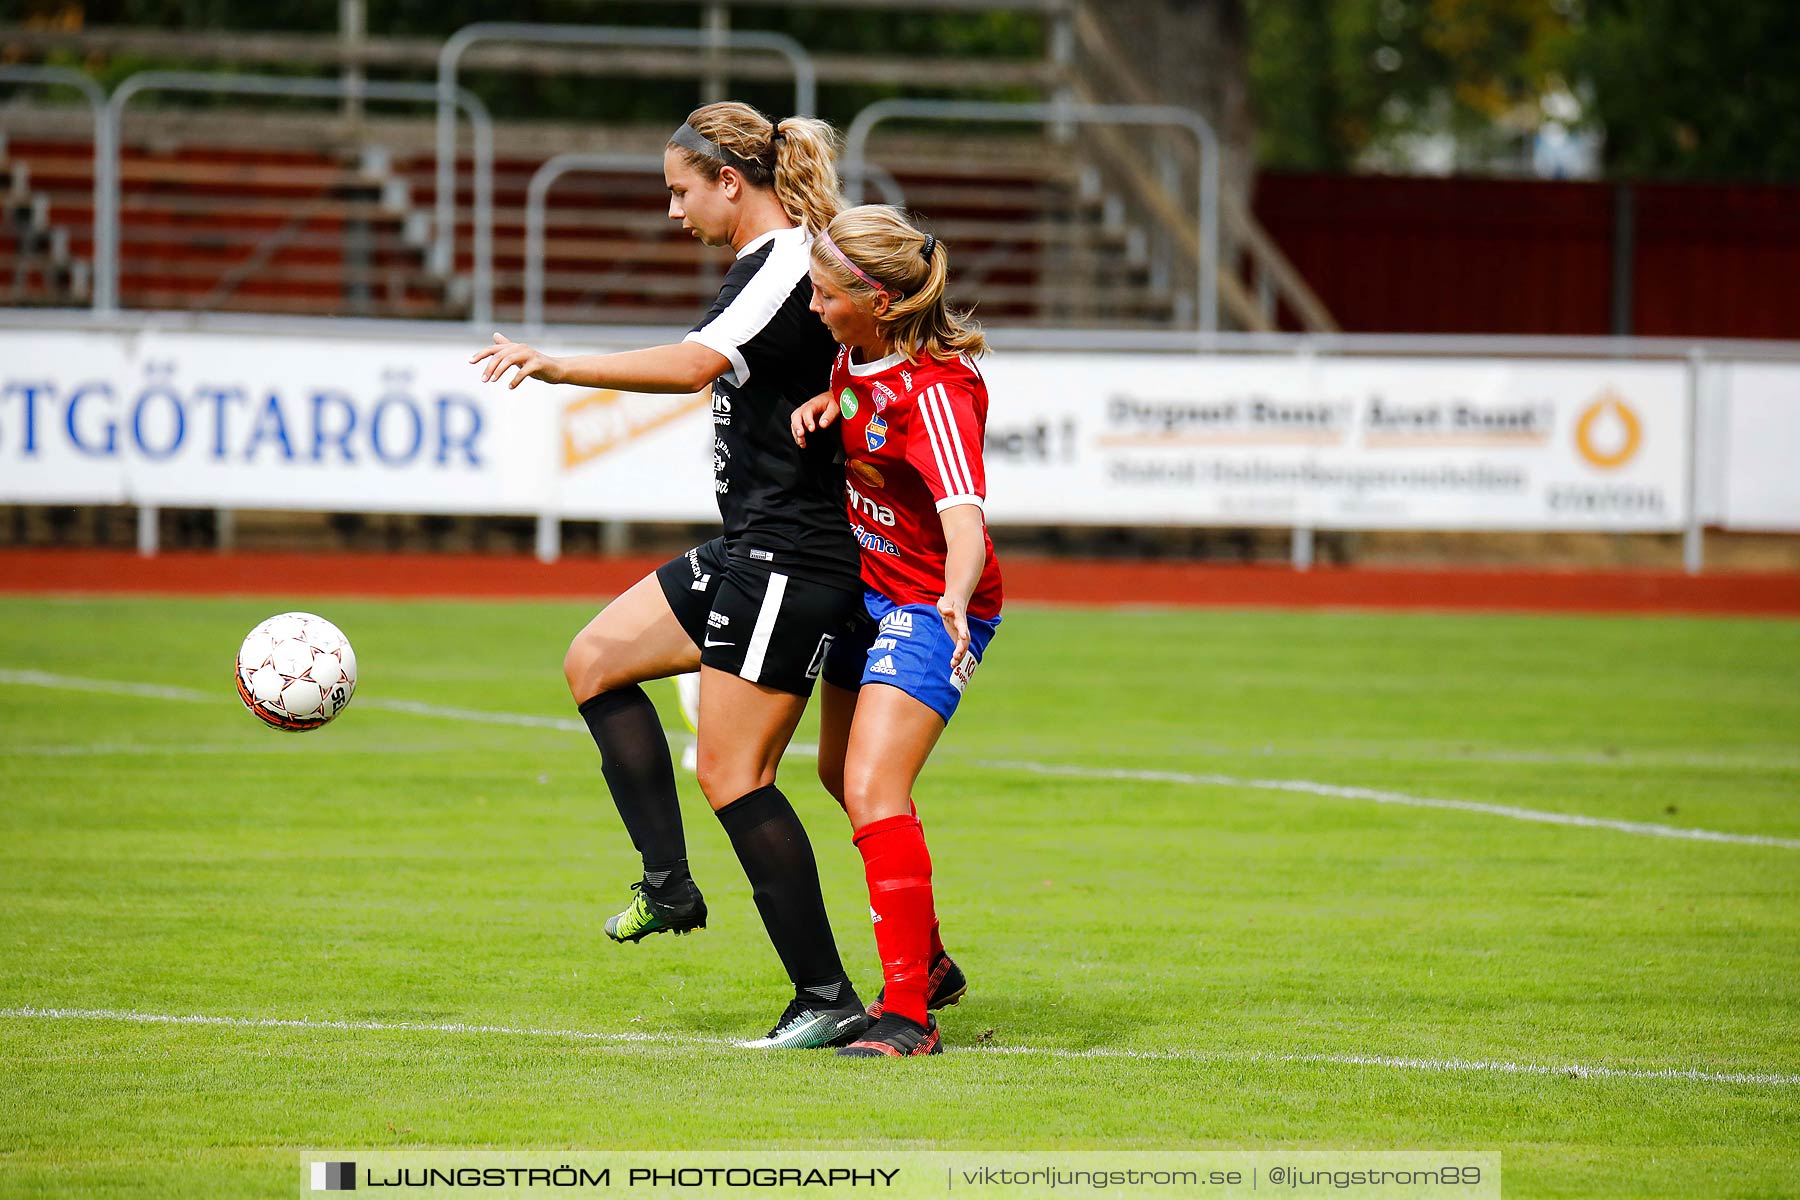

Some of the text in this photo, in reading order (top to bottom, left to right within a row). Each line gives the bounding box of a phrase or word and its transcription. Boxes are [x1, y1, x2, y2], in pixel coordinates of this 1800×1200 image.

[872, 380, 898, 403] PIZZERIA
[842, 393, 857, 413] dina
[0, 358, 485, 470] TGÖTARÖR
[850, 523, 901, 557] ima
[709, 611, 730, 626] ERS
[869, 665, 897, 676] adidas
